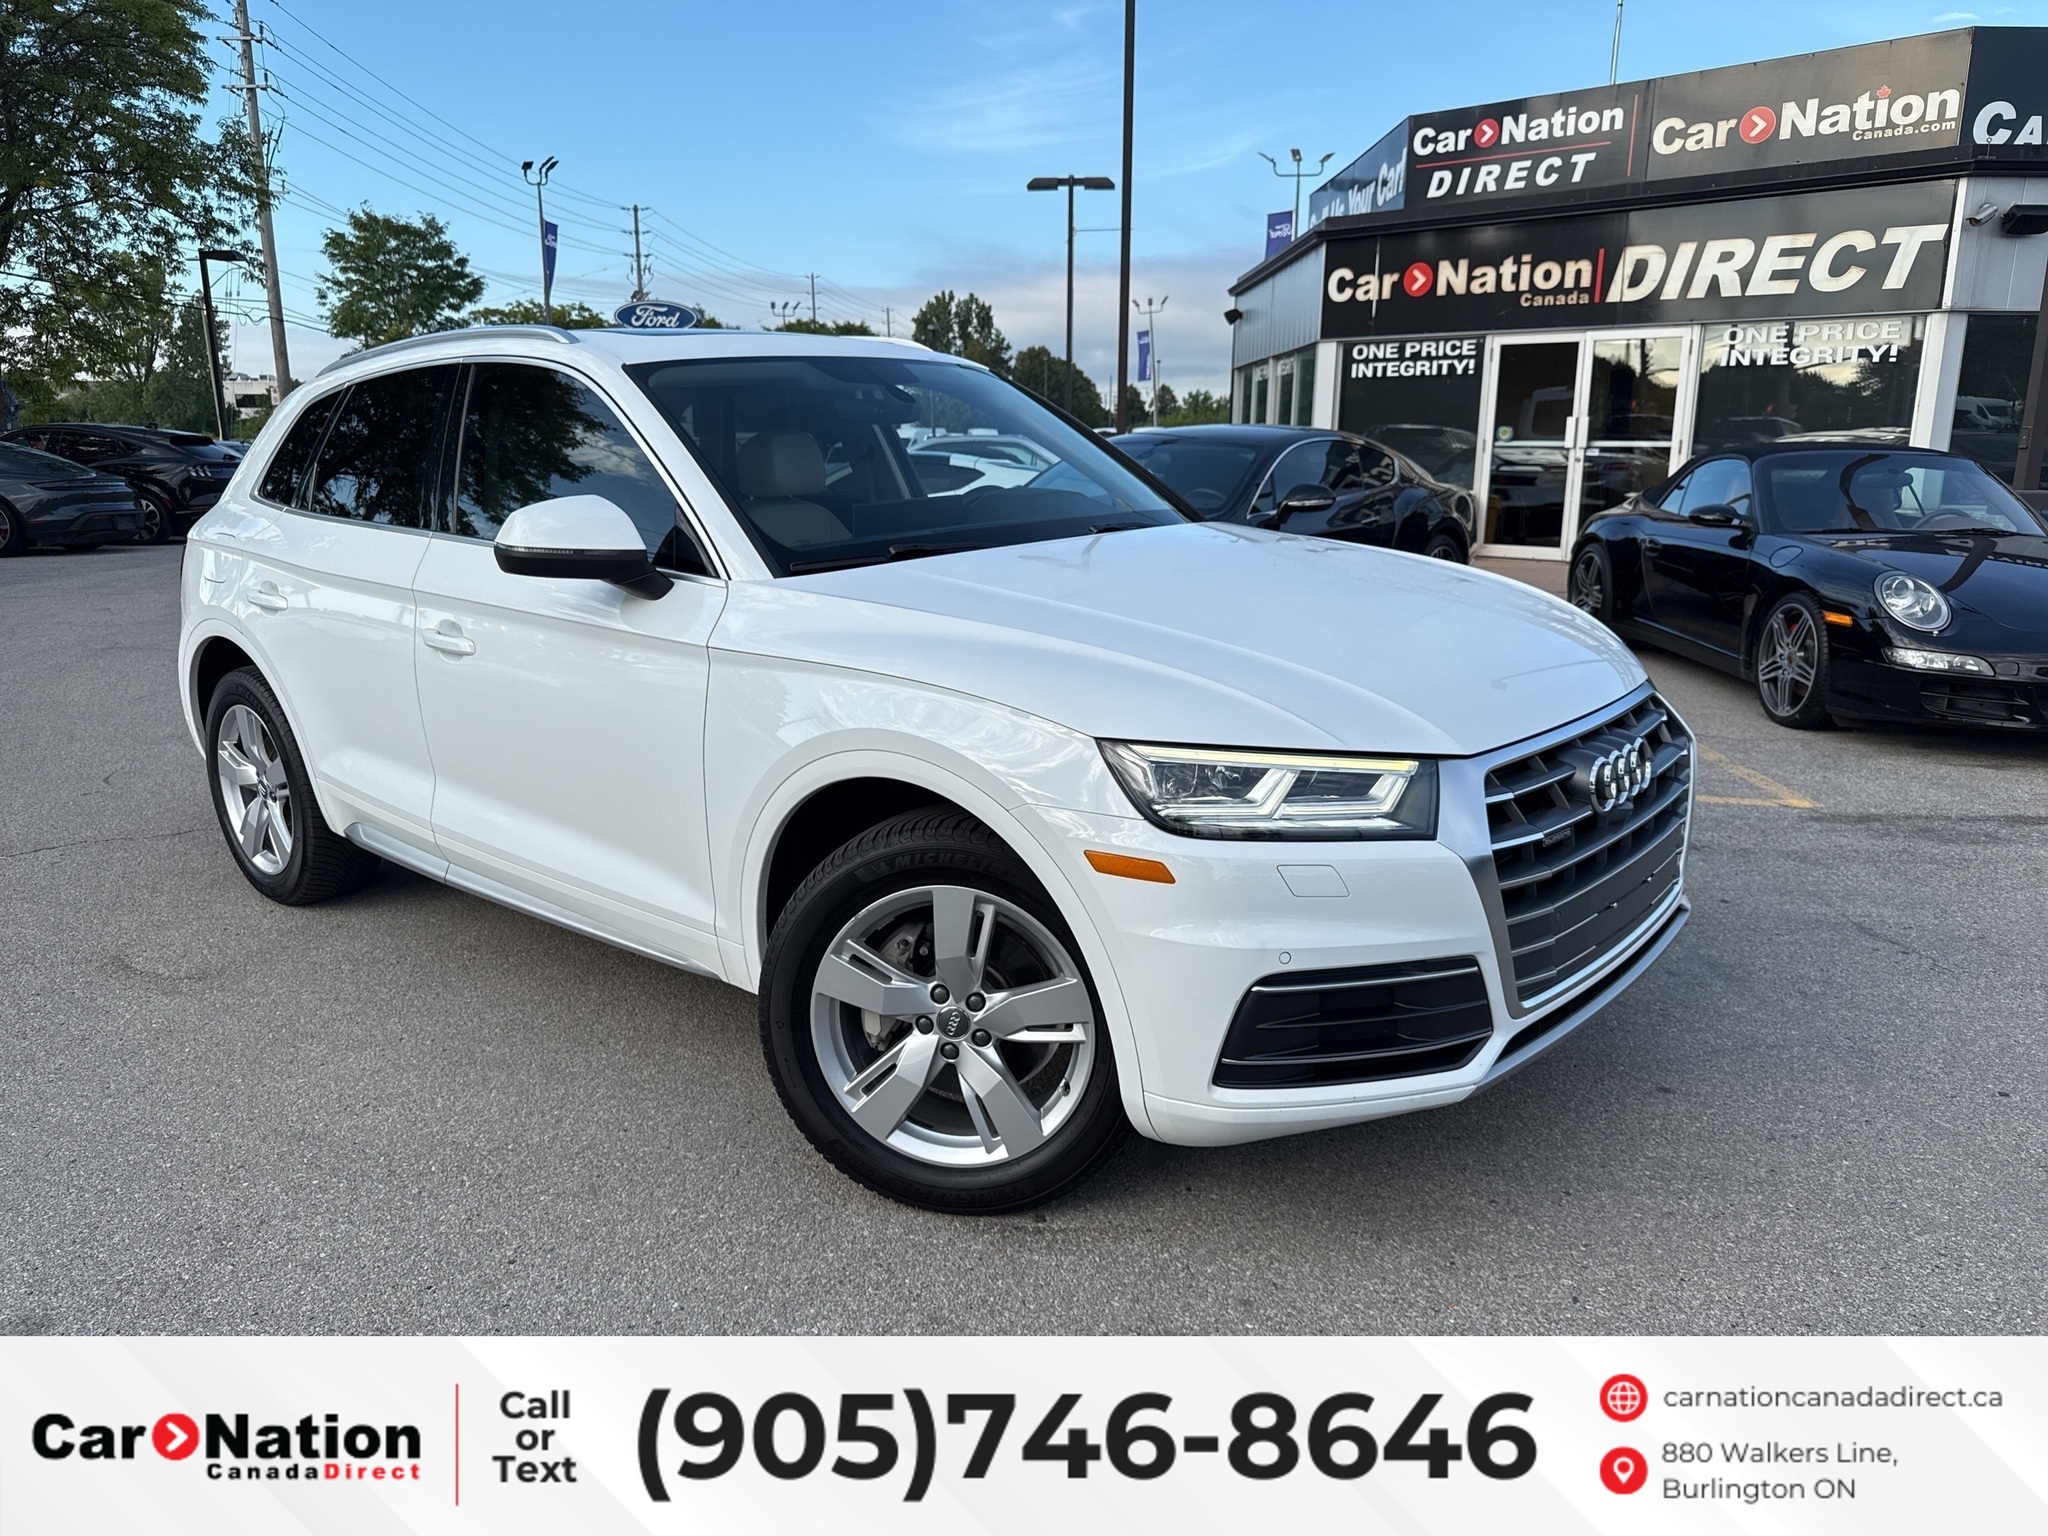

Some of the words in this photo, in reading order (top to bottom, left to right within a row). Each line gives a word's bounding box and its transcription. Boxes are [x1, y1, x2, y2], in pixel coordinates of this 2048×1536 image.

[1412, 126, 1473, 156] Car
[1501, 107, 1625, 145] Nation
[1652, 116, 1738, 155] Car
[1778, 85, 1961, 140] Nation
[1852, 120, 1956, 142] Canada.com
[1973, 101, 2048, 145] CA
[1348, 181, 1376, 216] Your
[1376, 147, 1407, 207] Car!
[1426, 152, 1597, 199] DIRECT
[1605, 223, 1949, 303] DIRECT
[1327, 267, 1400, 303] Car
[1436, 253, 1593, 297] Nation
[1520, 290, 1590, 308] Canada
[631, 304, 681, 329] Ford
[1722, 325, 1789, 346] ONE
[1794, 320, 1904, 343] PRICE
[1352, 342, 1399, 361] ONE
[1405, 339, 1477, 358] PRICE
[1720, 344, 1899, 367] INTEGRITY!
[1350, 358, 1475, 378] INTEGRITY!
[893, 852, 1006, 876] MICHELIN
